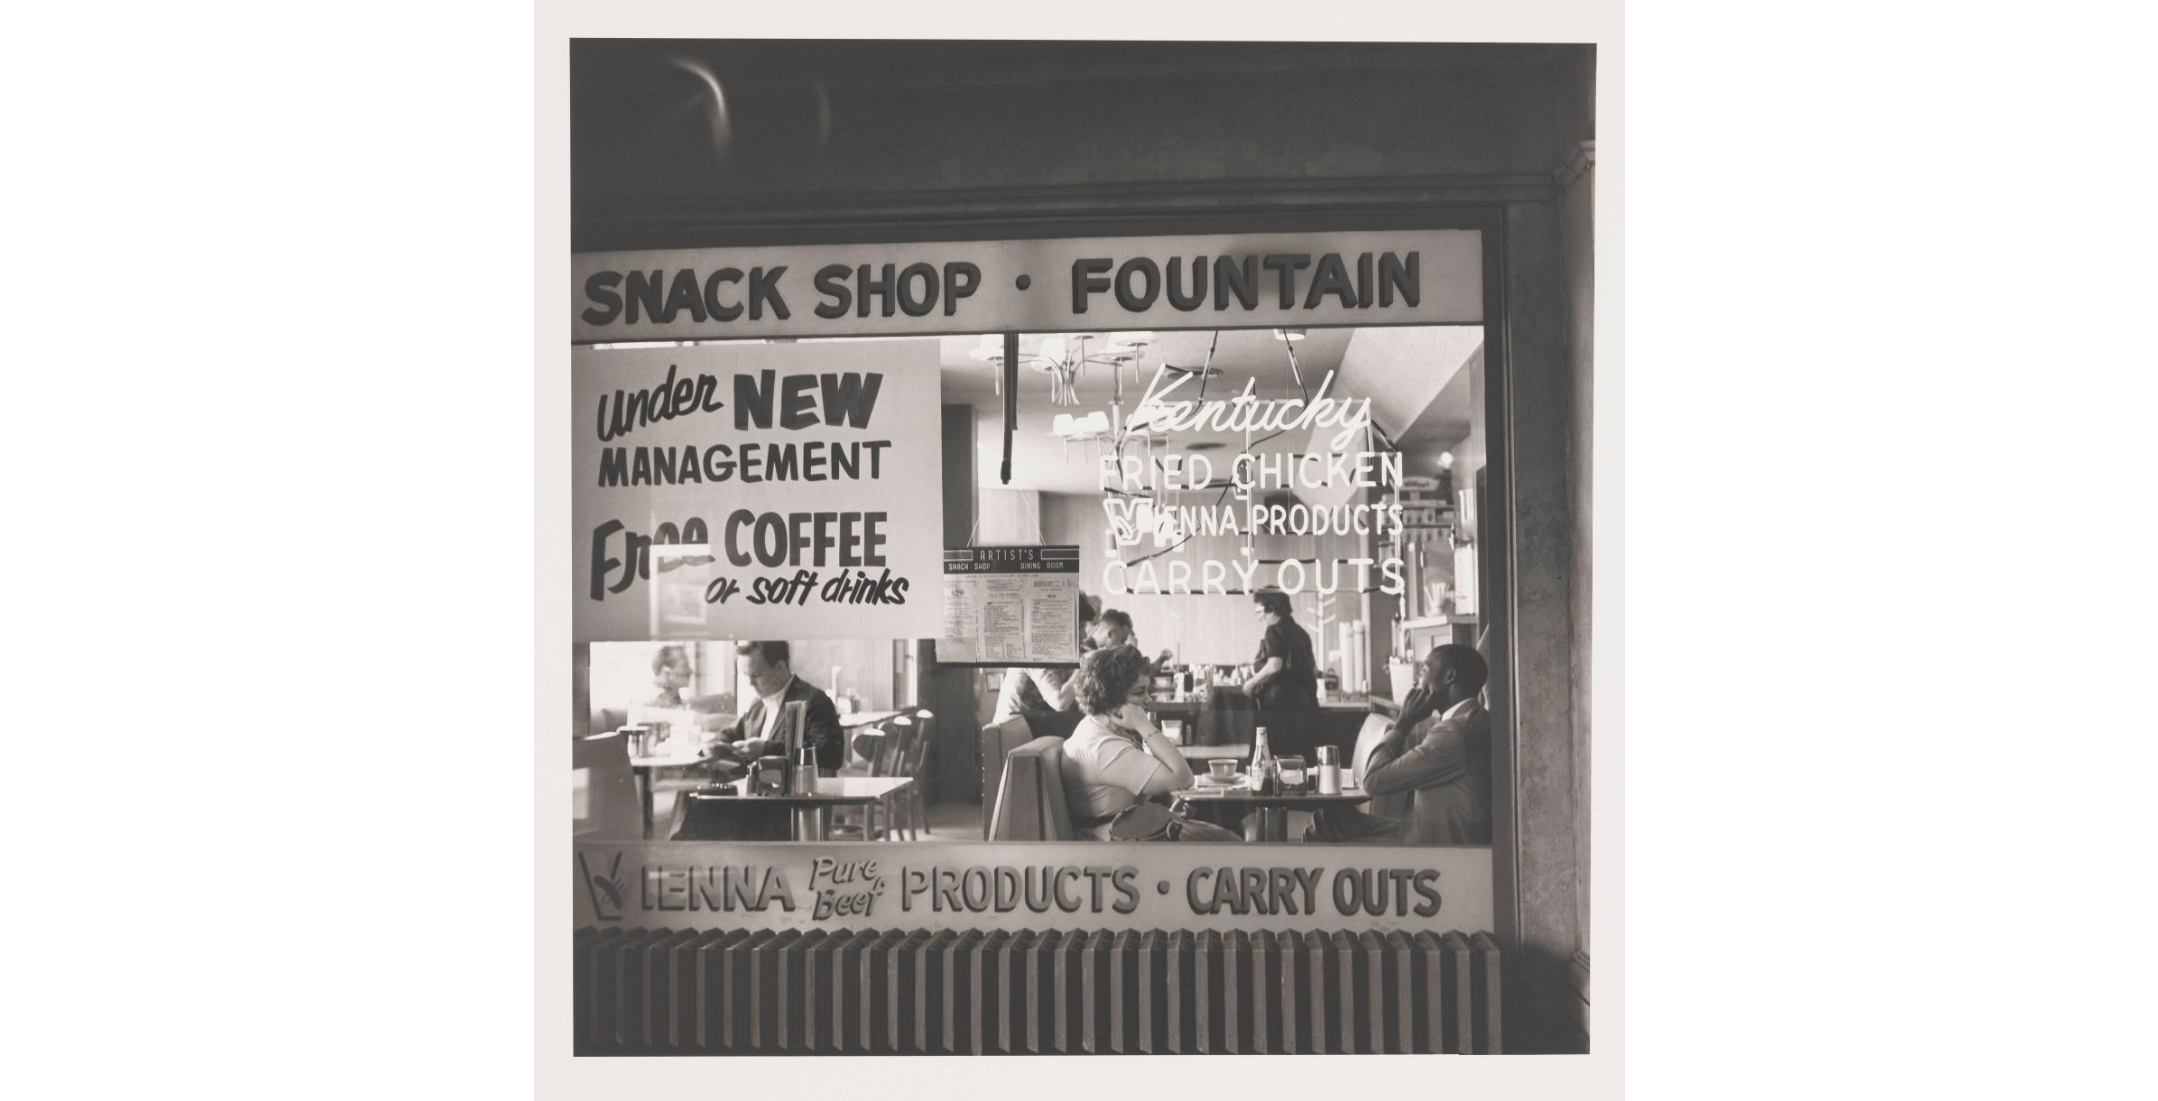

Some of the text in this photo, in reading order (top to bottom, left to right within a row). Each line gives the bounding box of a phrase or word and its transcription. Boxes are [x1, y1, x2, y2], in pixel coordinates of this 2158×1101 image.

[581, 251, 1421, 326] SNACK SHOP FOUNTAIN
[597, 364, 884, 442] under NEW
[1125, 362, 1372, 451] Kentucky
[597, 440, 892, 487] MANAGEMENT
[1099, 451, 1404, 491] FRIED CHICKEN
[724, 508, 888, 568] COFFEE
[1252, 504, 1404, 536] PRODUCTS
[948, 562, 991, 571] SNACK SHOP
[980, 549, 1034, 561] ARTIST'S
[1020, 561, 1064, 570] DINING ROOM
[704, 568, 909, 606] or soft drinks
[1102, 557, 1406, 596] CARRY OUTS
[808, 855, 879, 891] Pure
[901, 864, 1140, 915] PRODUCTS
[1186, 866, 1325, 916] CARRY
[1332, 867, 1443, 917] OUTS
[812, 876, 887, 921] Beef
